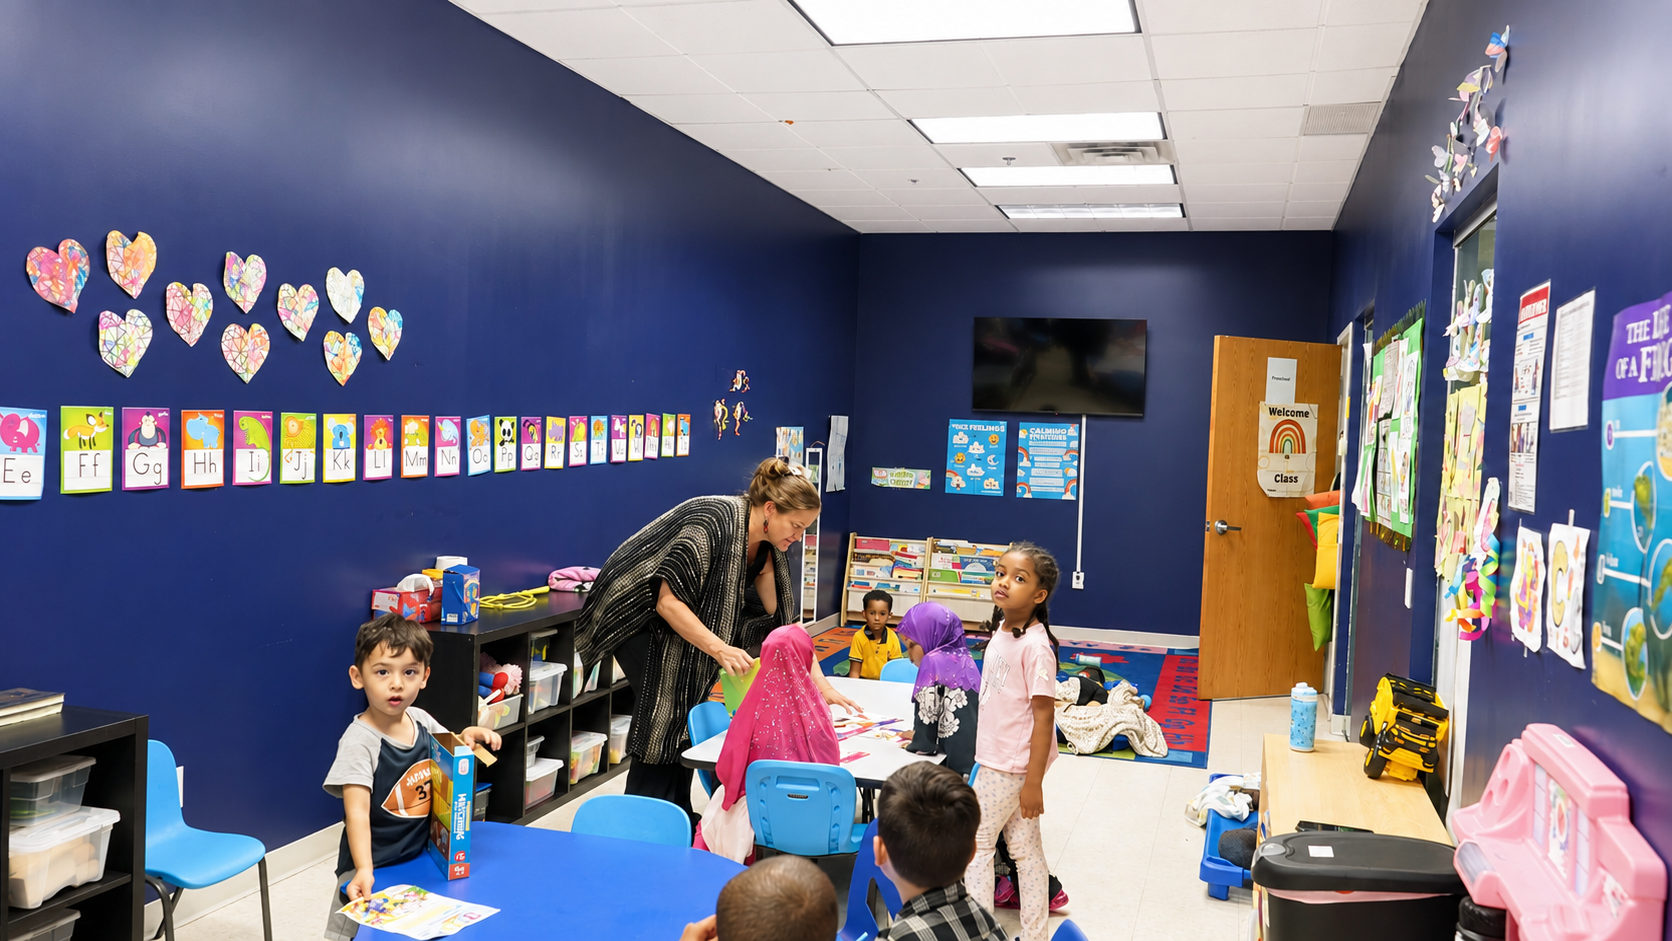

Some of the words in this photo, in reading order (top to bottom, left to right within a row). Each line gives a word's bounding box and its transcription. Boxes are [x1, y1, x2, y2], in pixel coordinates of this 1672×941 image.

[1626, 319, 1651, 344] THE
[1615, 357, 1629, 380] OF
[1628, 355, 1638, 378] A
[1268, 406, 1310, 418] Welcome
[249, 451, 261, 473] Ii
[333, 449, 351, 470] Kk
[374, 450, 386, 468] Ll
[405, 450, 427, 467] Mm
[441, 449, 457, 466] Nn
[472, 448, 488, 464] Oo
[501, 447, 514, 467] Pp
[551, 444, 561, 460] Rr
[3, 457, 31, 484] Ee
[79, 453, 101, 478] Ff
[133, 452, 162, 485] Gg
[193, 452, 217, 474] Hh
[294, 451, 308, 480] Jj
[1274, 473, 1299, 484] Class
